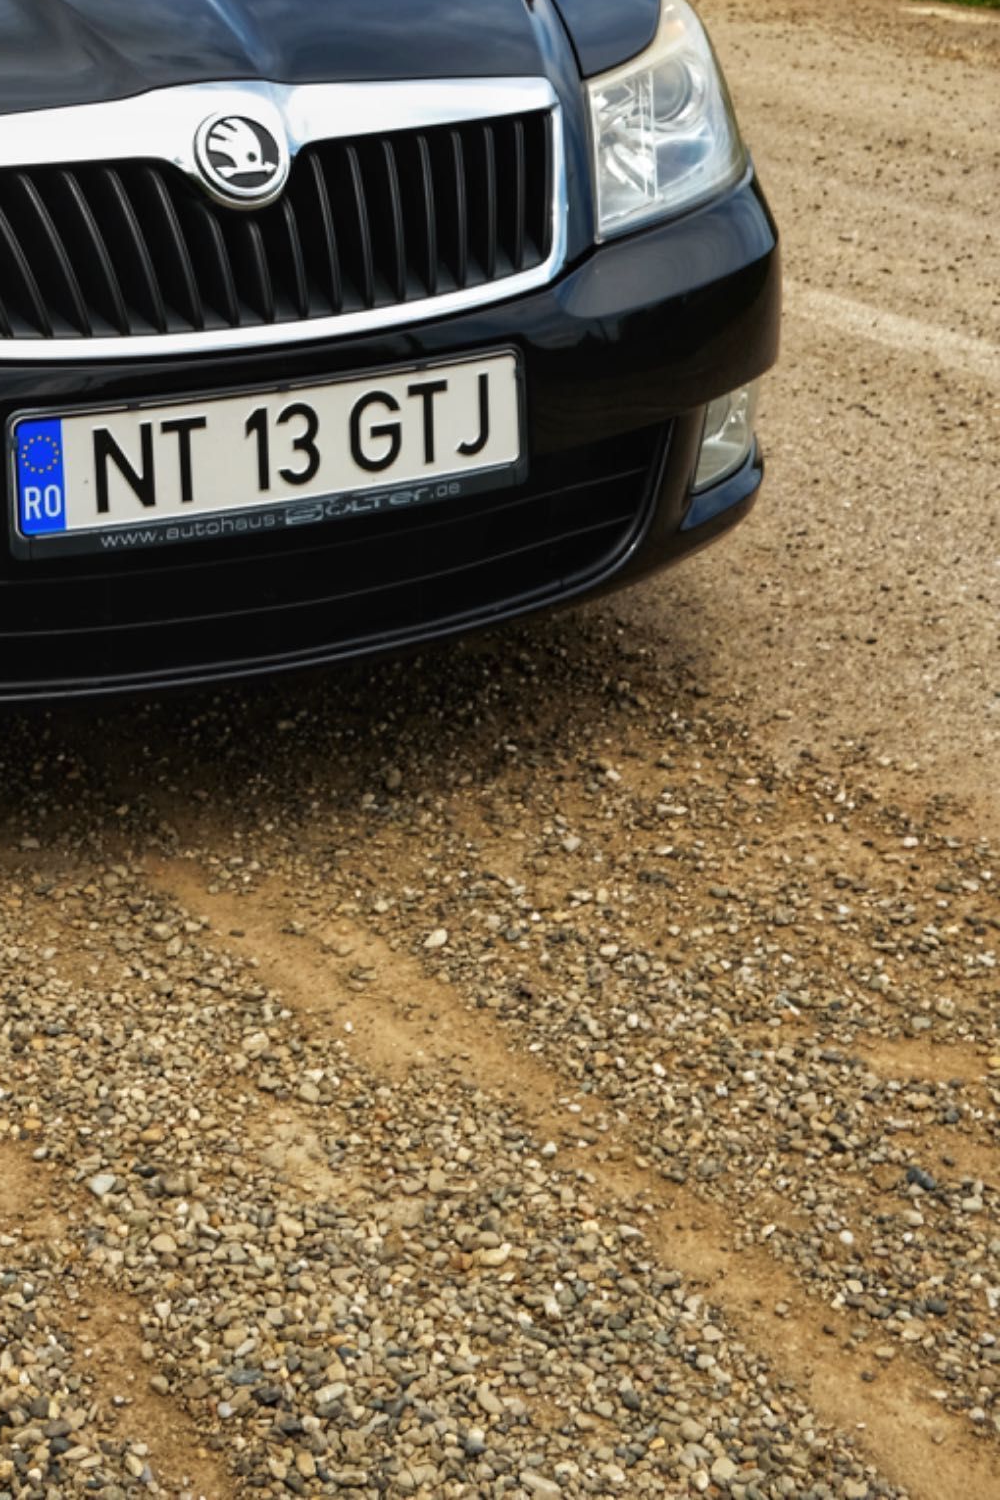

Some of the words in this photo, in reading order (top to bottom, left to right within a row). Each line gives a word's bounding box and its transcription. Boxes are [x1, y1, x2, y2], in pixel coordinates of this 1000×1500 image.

[92, 416, 207, 514] NT
[245, 402, 320, 491] 13
[349, 372, 490, 472] GTJ
[23, 484, 62, 521] RO
